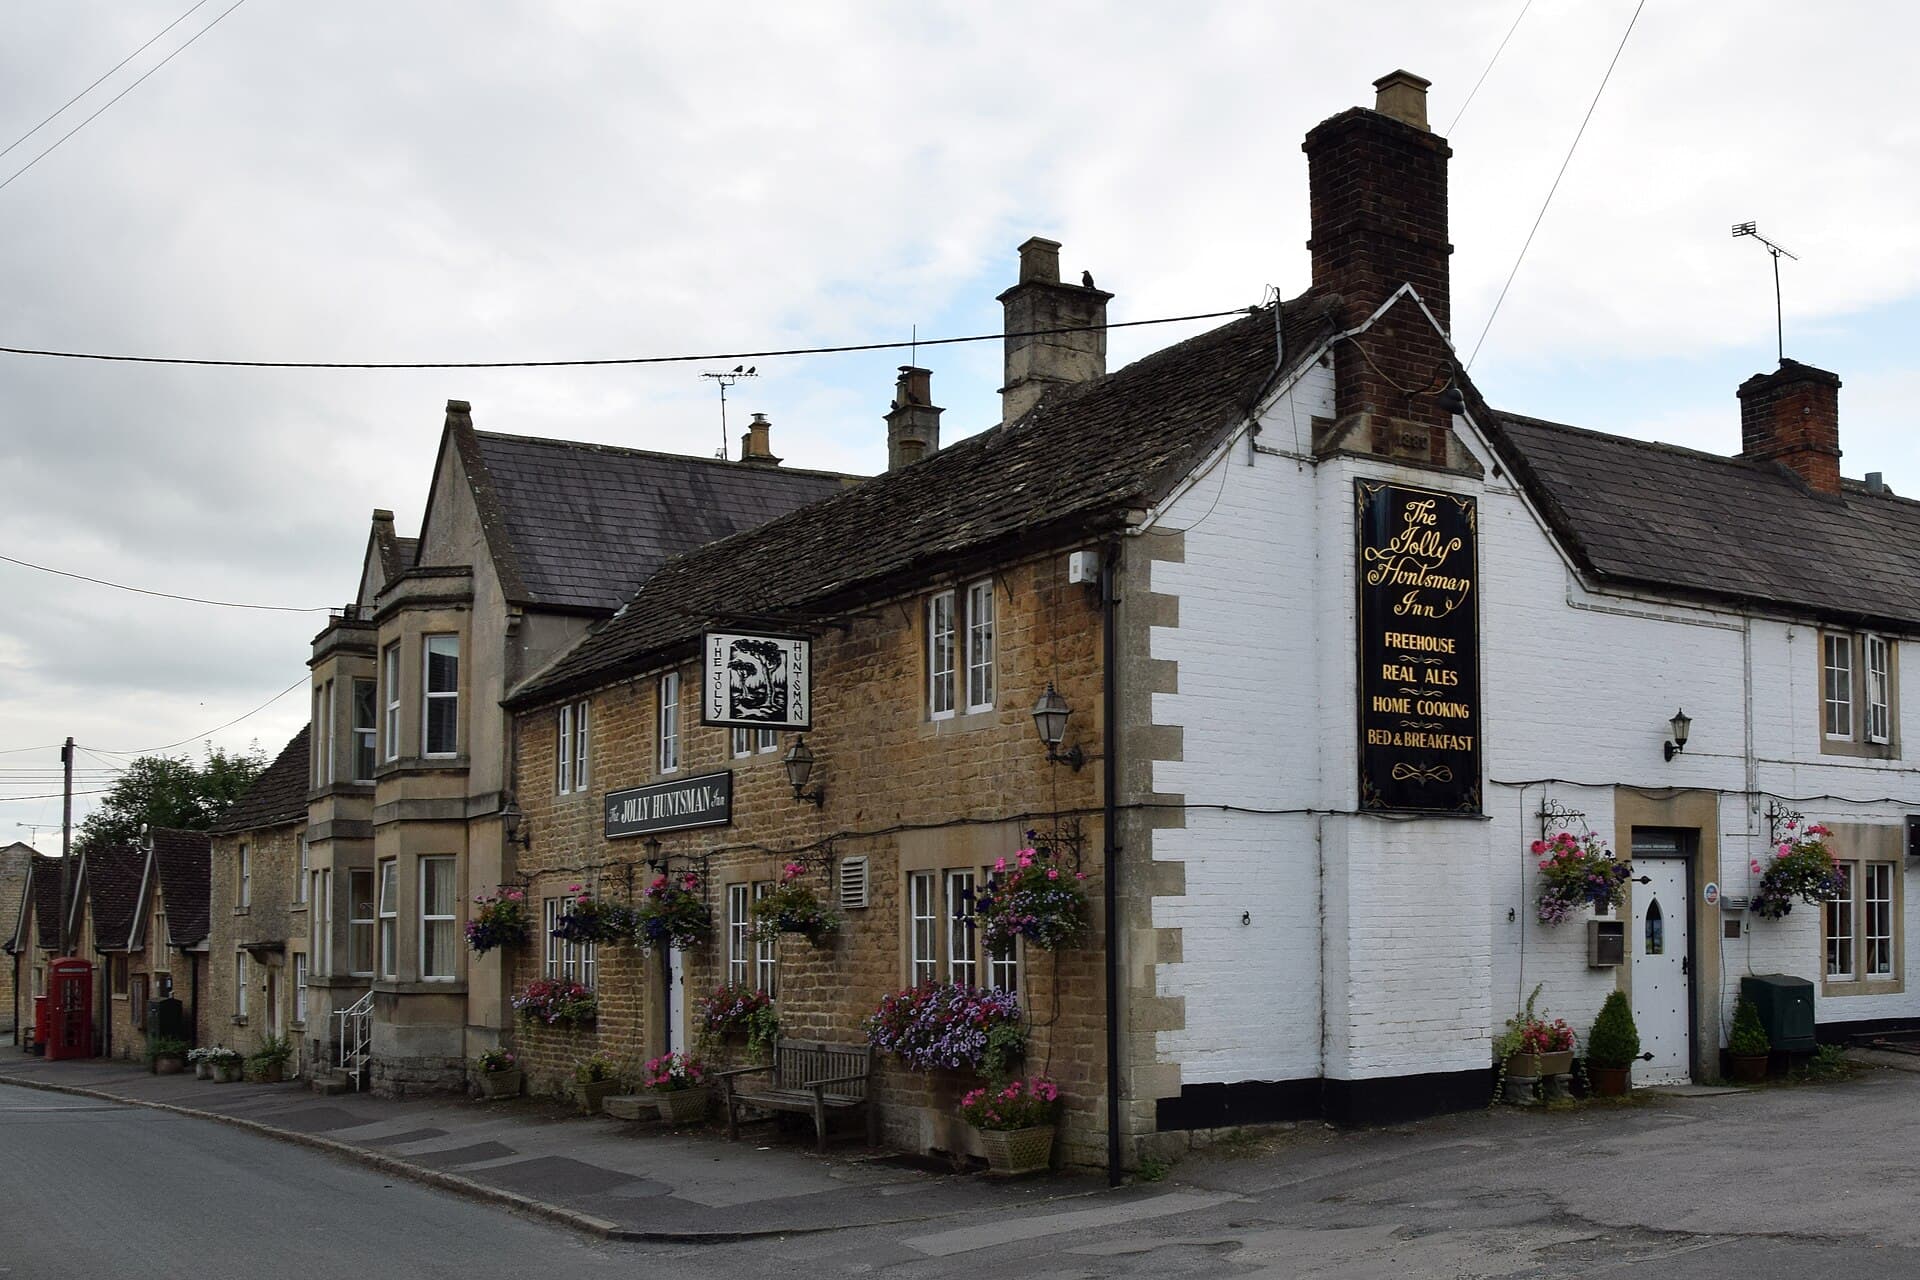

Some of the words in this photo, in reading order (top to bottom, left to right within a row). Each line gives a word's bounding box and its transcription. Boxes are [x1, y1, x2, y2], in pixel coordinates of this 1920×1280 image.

[1404, 500, 1437, 525] The
[1365, 526, 1462, 570] Jolly
[1367, 556, 1470, 592] Huntsman
[1393, 590, 1442, 618] Inn
[713, 637, 723, 667] THE
[1384, 631, 1456, 654] FREEHOUSE
[792, 642, 804, 721] HUNTSMAN
[1382, 664, 1418, 683] REAL
[1424, 668, 1459, 687] ALES
[713, 672, 723, 720] JOLLY
[1372, 696, 1412, 715] HOME
[1416, 700, 1470, 719] COOKING
[1367, 728, 1393, 746] BED
[1404, 731, 1473, 751] BREAKFAST
[608, 803, 620, 823] The
[621, 796, 650, 824] JOLLY
[652, 785, 712, 820] HUNTSMAN
[711, 787, 726, 808] Inn
